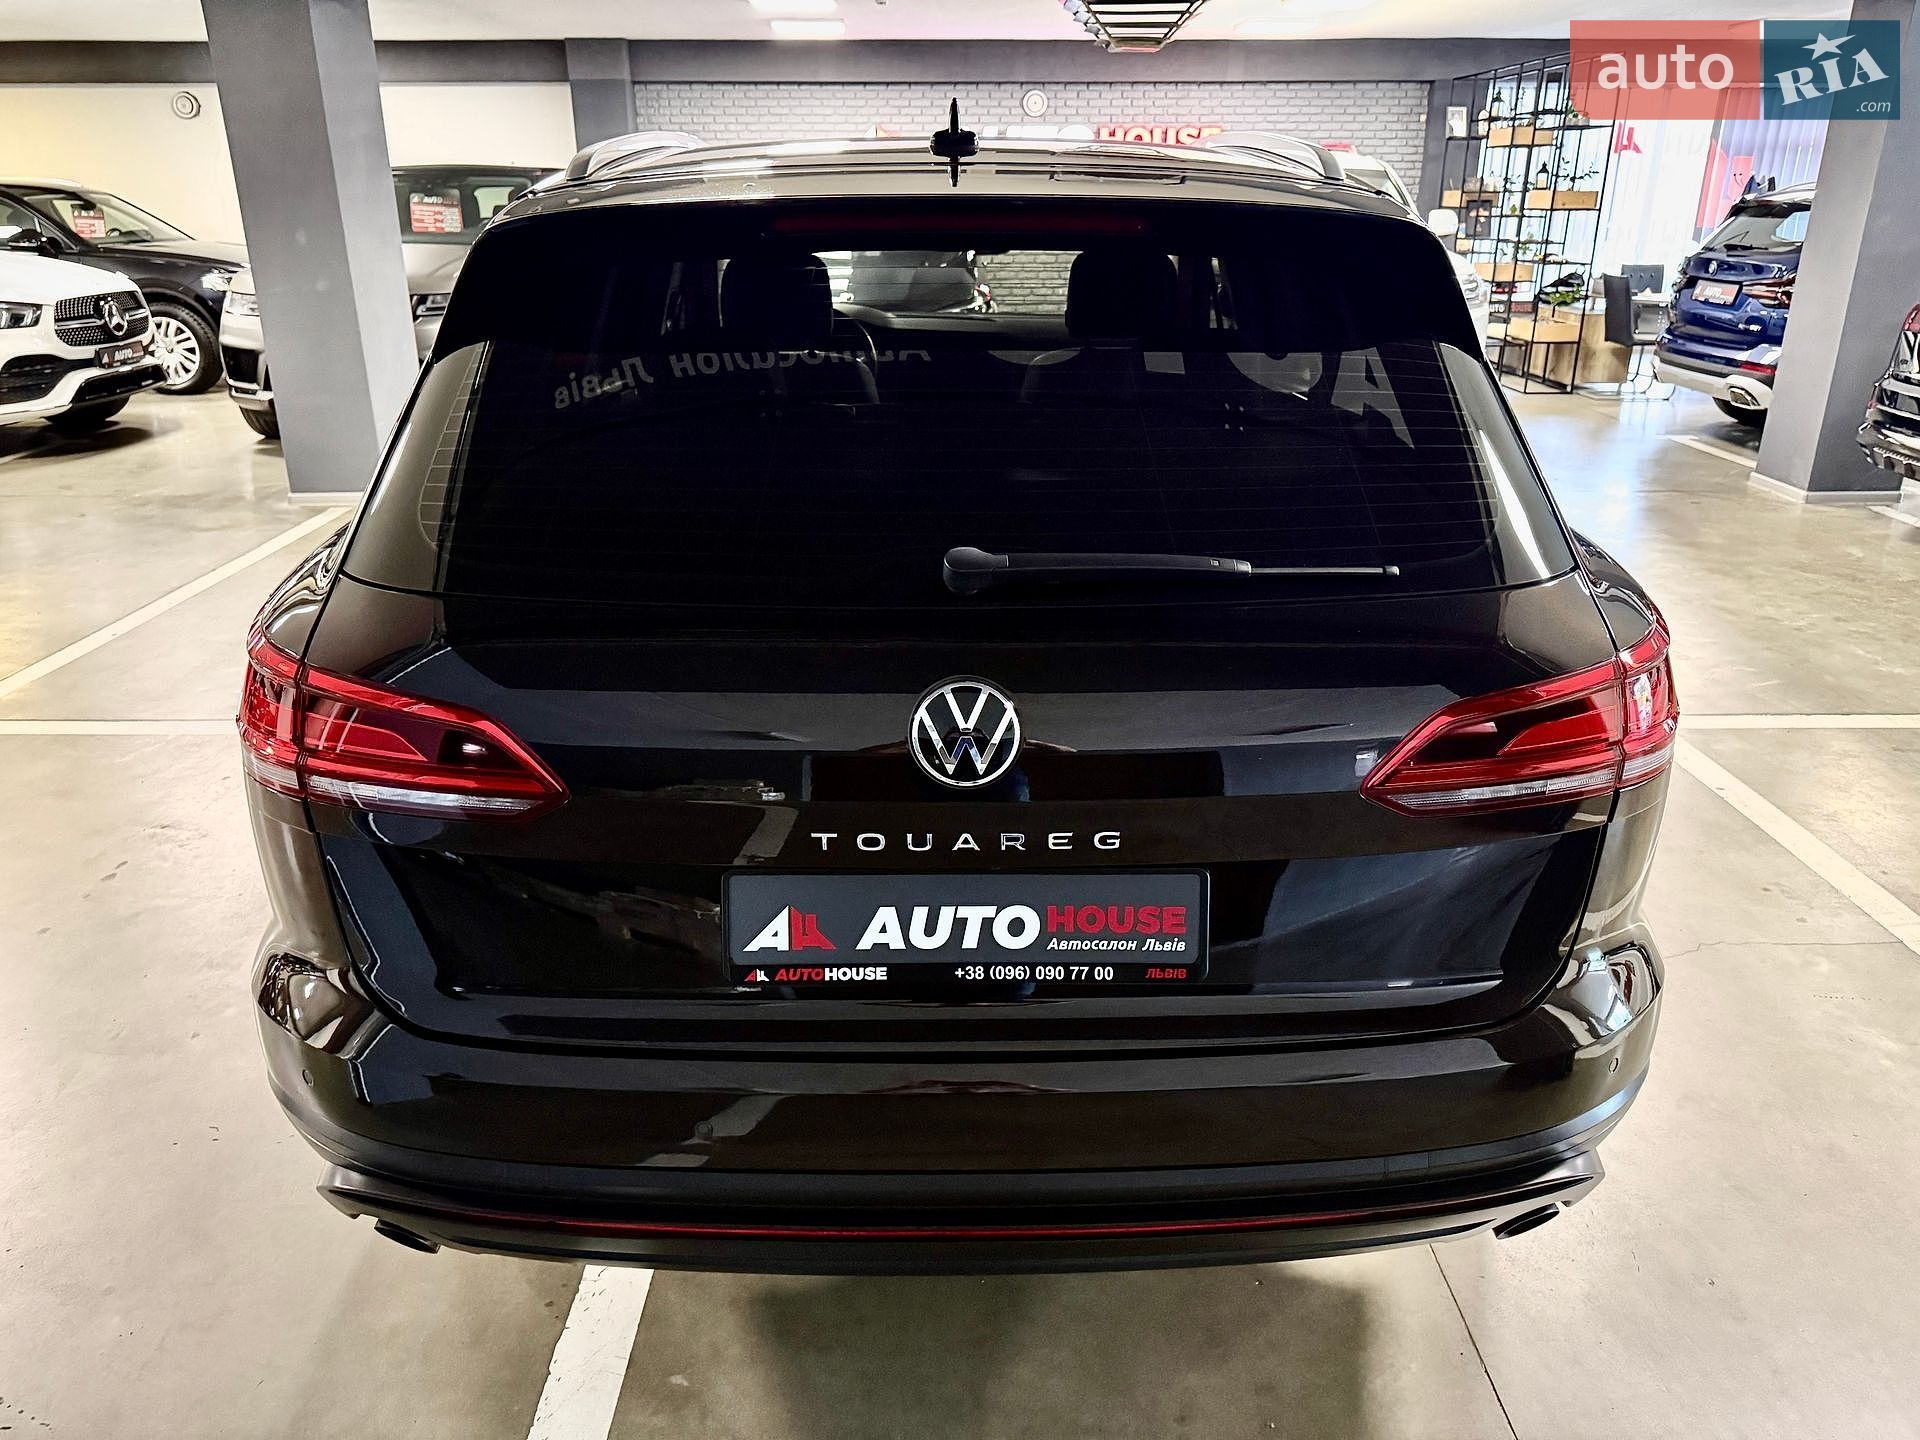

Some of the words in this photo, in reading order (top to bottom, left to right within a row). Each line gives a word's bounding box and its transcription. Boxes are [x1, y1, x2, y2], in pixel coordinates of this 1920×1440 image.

[1489, 303, 1506, 313] UTO
[811, 831, 1121, 851] TOUAREG
[855, 904, 1041, 950] AUTO
[1047, 905, 1187, 934] HOUSE
[1047, 938, 1138, 951] Автосалон
[1142, 938, 1187, 952] Львів
[954, 966, 984, 980] +38
[990, 965, 1030, 981] (096)
[1035, 966, 1064, 980] 090
[1070, 966, 1089, 980] 77
[1094, 966, 1114, 980] 00
